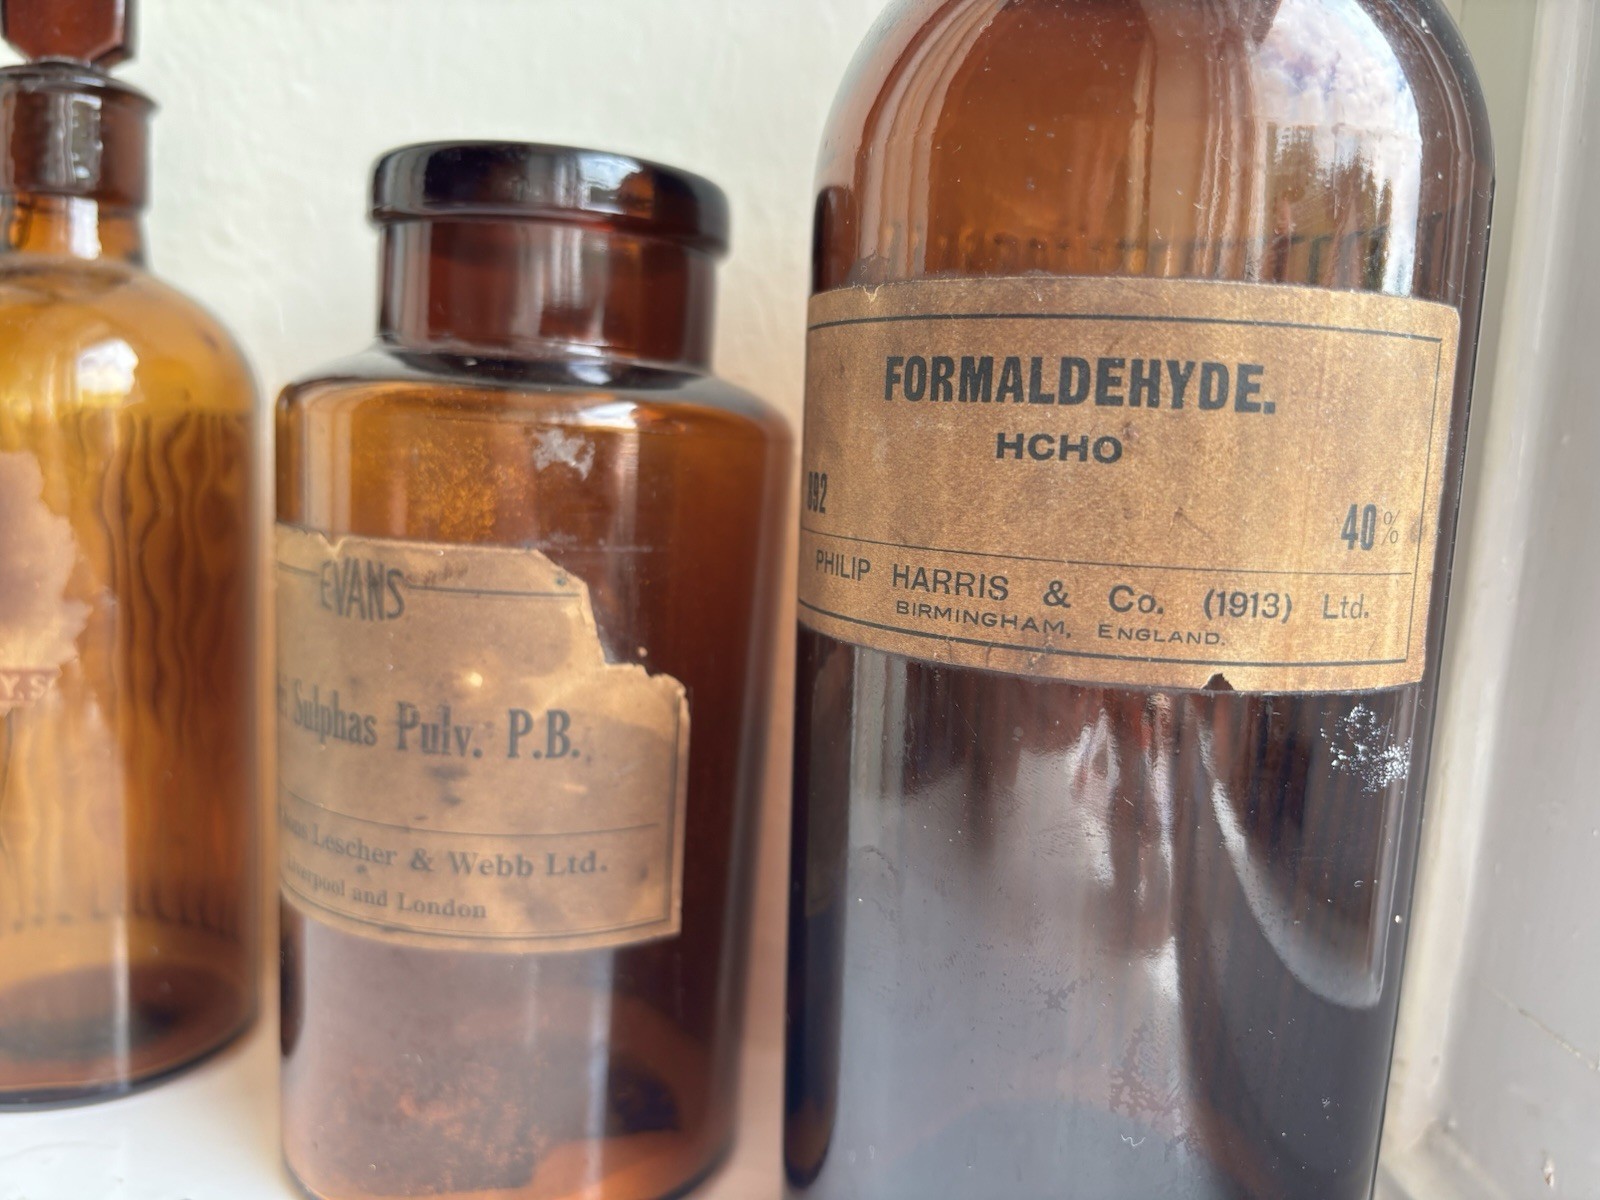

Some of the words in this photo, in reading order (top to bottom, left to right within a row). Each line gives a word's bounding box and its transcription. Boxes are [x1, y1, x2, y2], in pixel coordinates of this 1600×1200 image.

[884, 355, 1276, 414] FORMALDEHYDE.
[995, 432, 1124, 465] HCHO
[321, 557, 405, 621] EVANS
[815, 549, 872, 582] PHILIP
[892, 563, 1009, 601] HARRIS
[1042, 579, 1071, 609] &
[1108, 584, 1165, 615] Co.
[1203, 587, 1293, 624] (1913)
[1322, 593, 1370, 620] Ltd.
[896, 600, 1071, 639] BIRMINGHAM,
[1097, 624, 1226, 647] ENGLAND.
[396, 701, 483, 758] Pulv.
[507, 708, 580, 759] P.B.
[311, 823, 397, 865] Lescher
[409, 848, 434, 872] &
[447, 850, 534, 878] Webb
[546, 850, 608, 876] Ltd.
[352, 886, 388, 908] and
[397, 891, 487, 919] London
